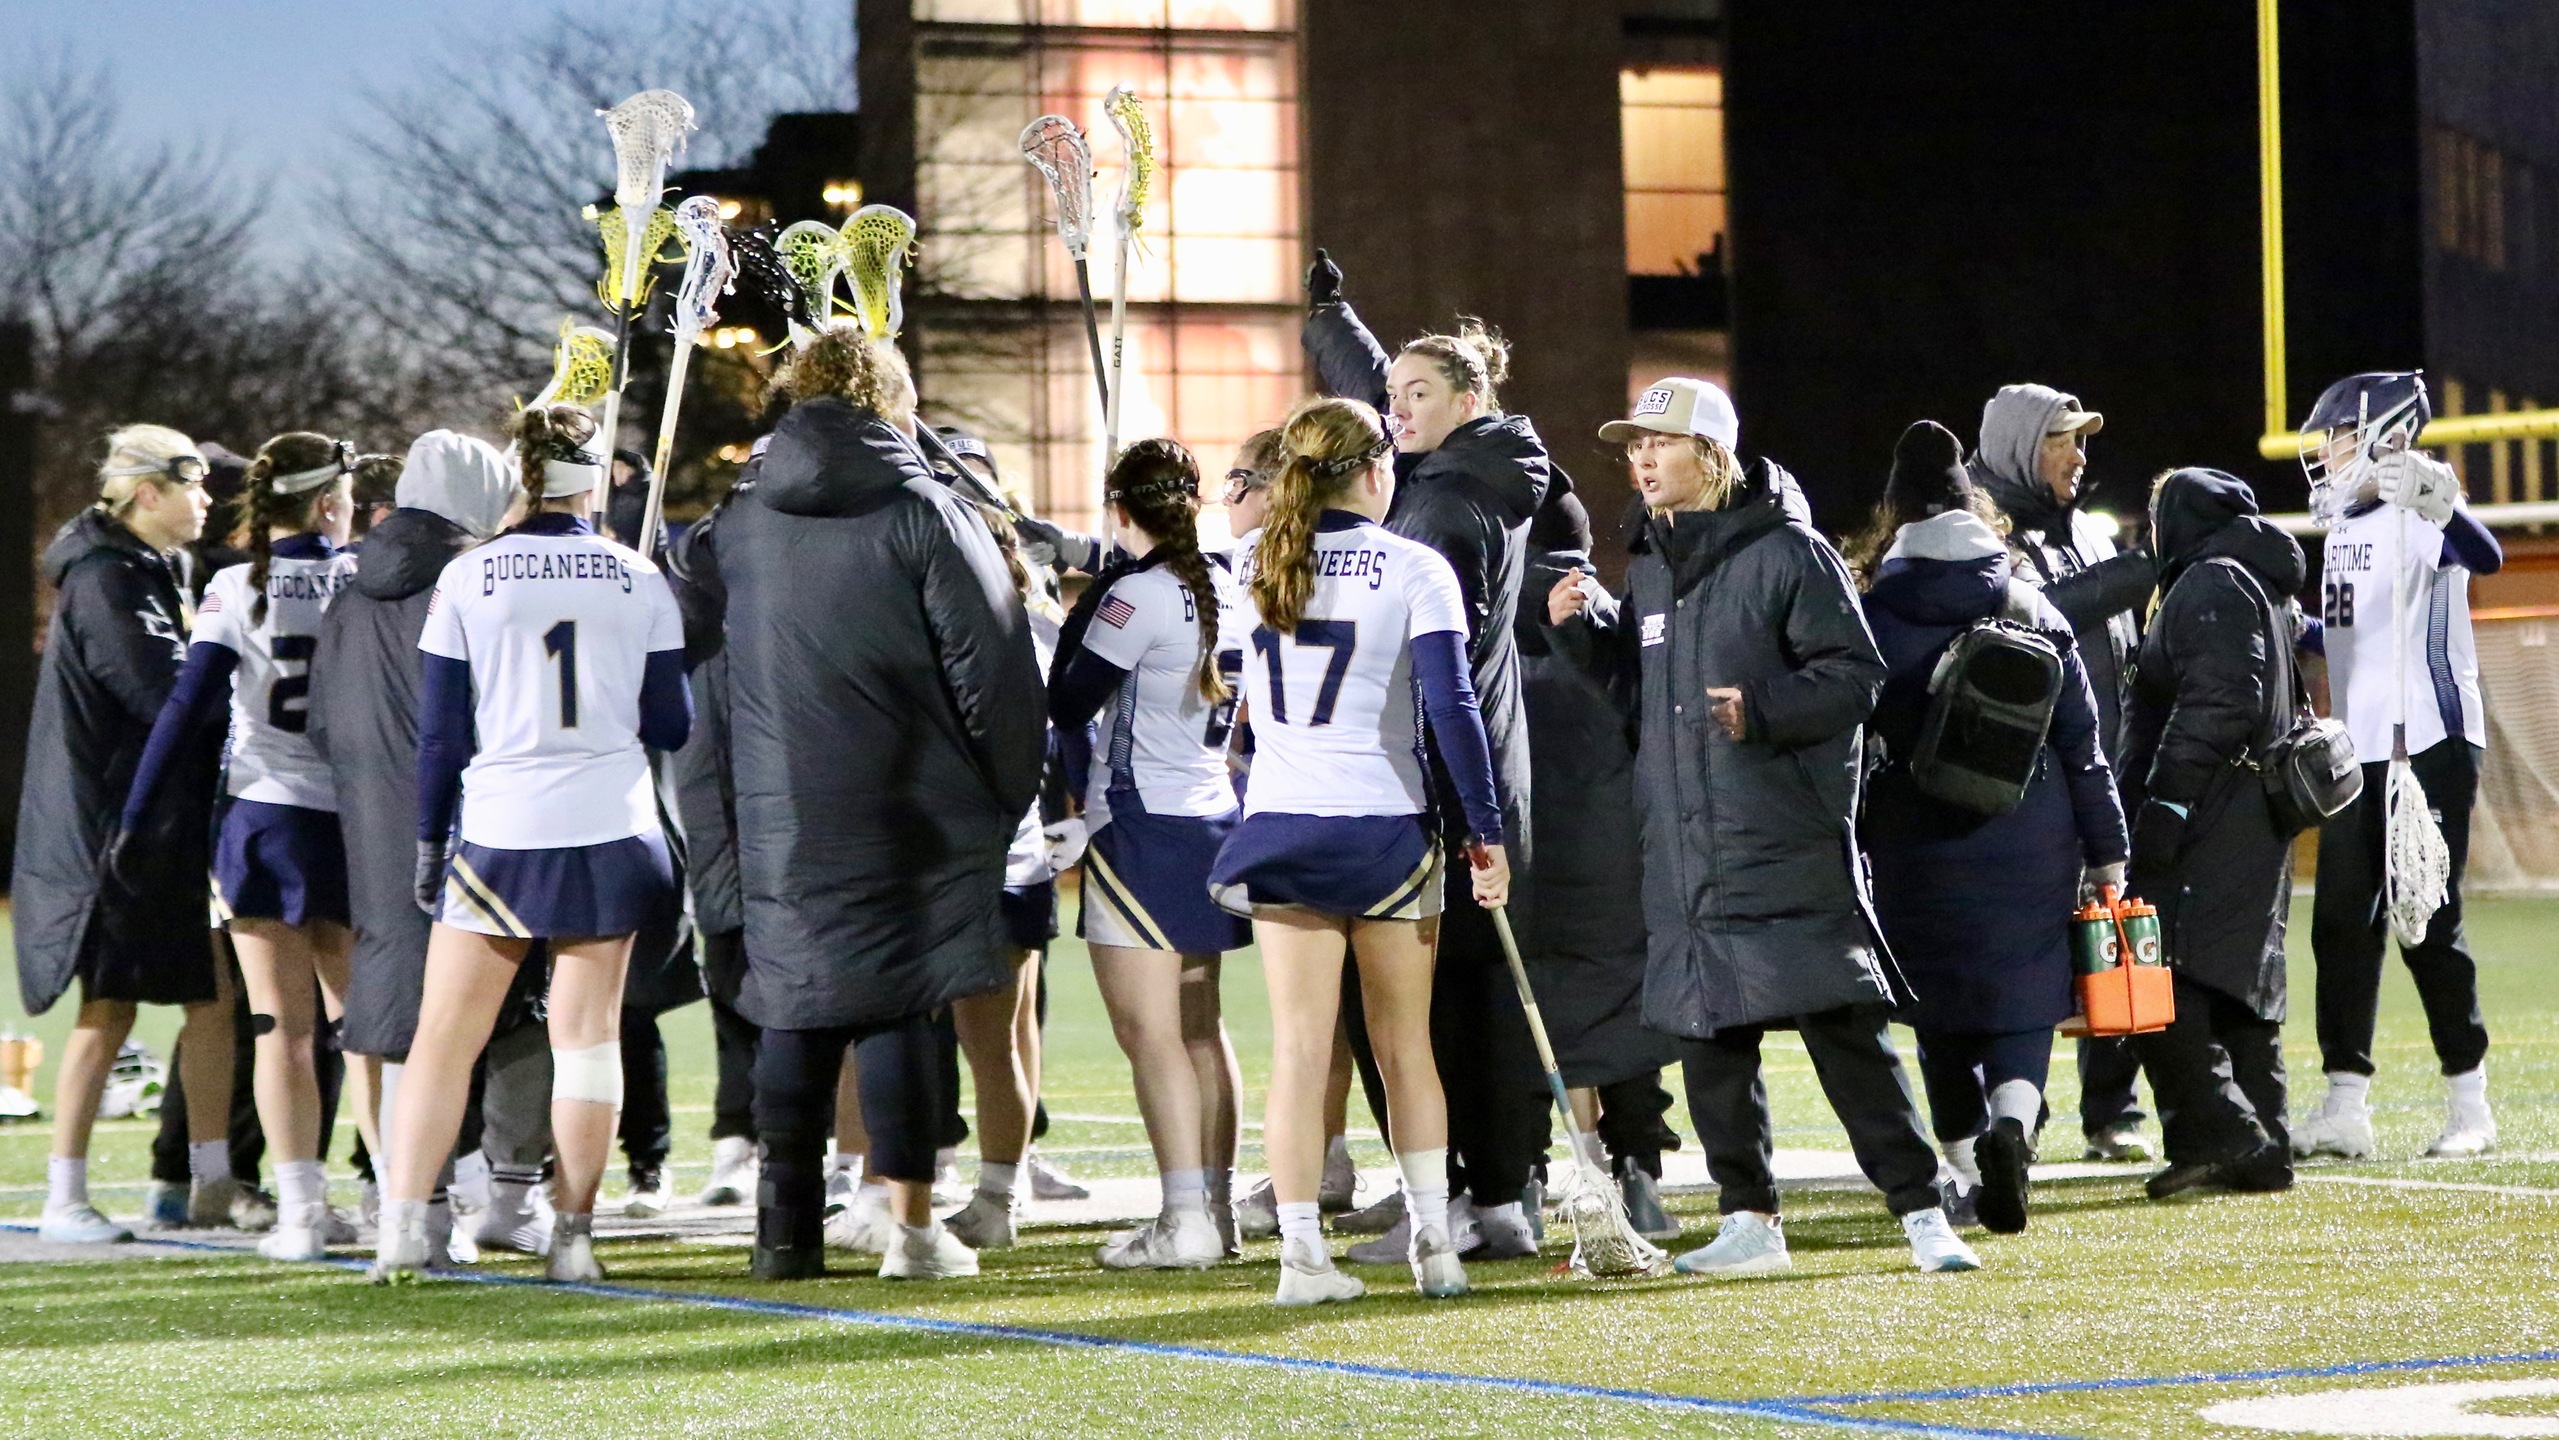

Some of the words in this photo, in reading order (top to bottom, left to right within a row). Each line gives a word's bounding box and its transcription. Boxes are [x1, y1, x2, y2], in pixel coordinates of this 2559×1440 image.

[1113, 336, 1122, 368] GAIT
[948, 439, 982, 449] BUC
[483, 553, 632, 597] BUCCANEERS
[2326, 544, 2373, 573] ARITIME
[2324, 583, 2354, 628] 28
[542, 619, 578, 731] 1
[1250, 618, 1358, 728] 17
